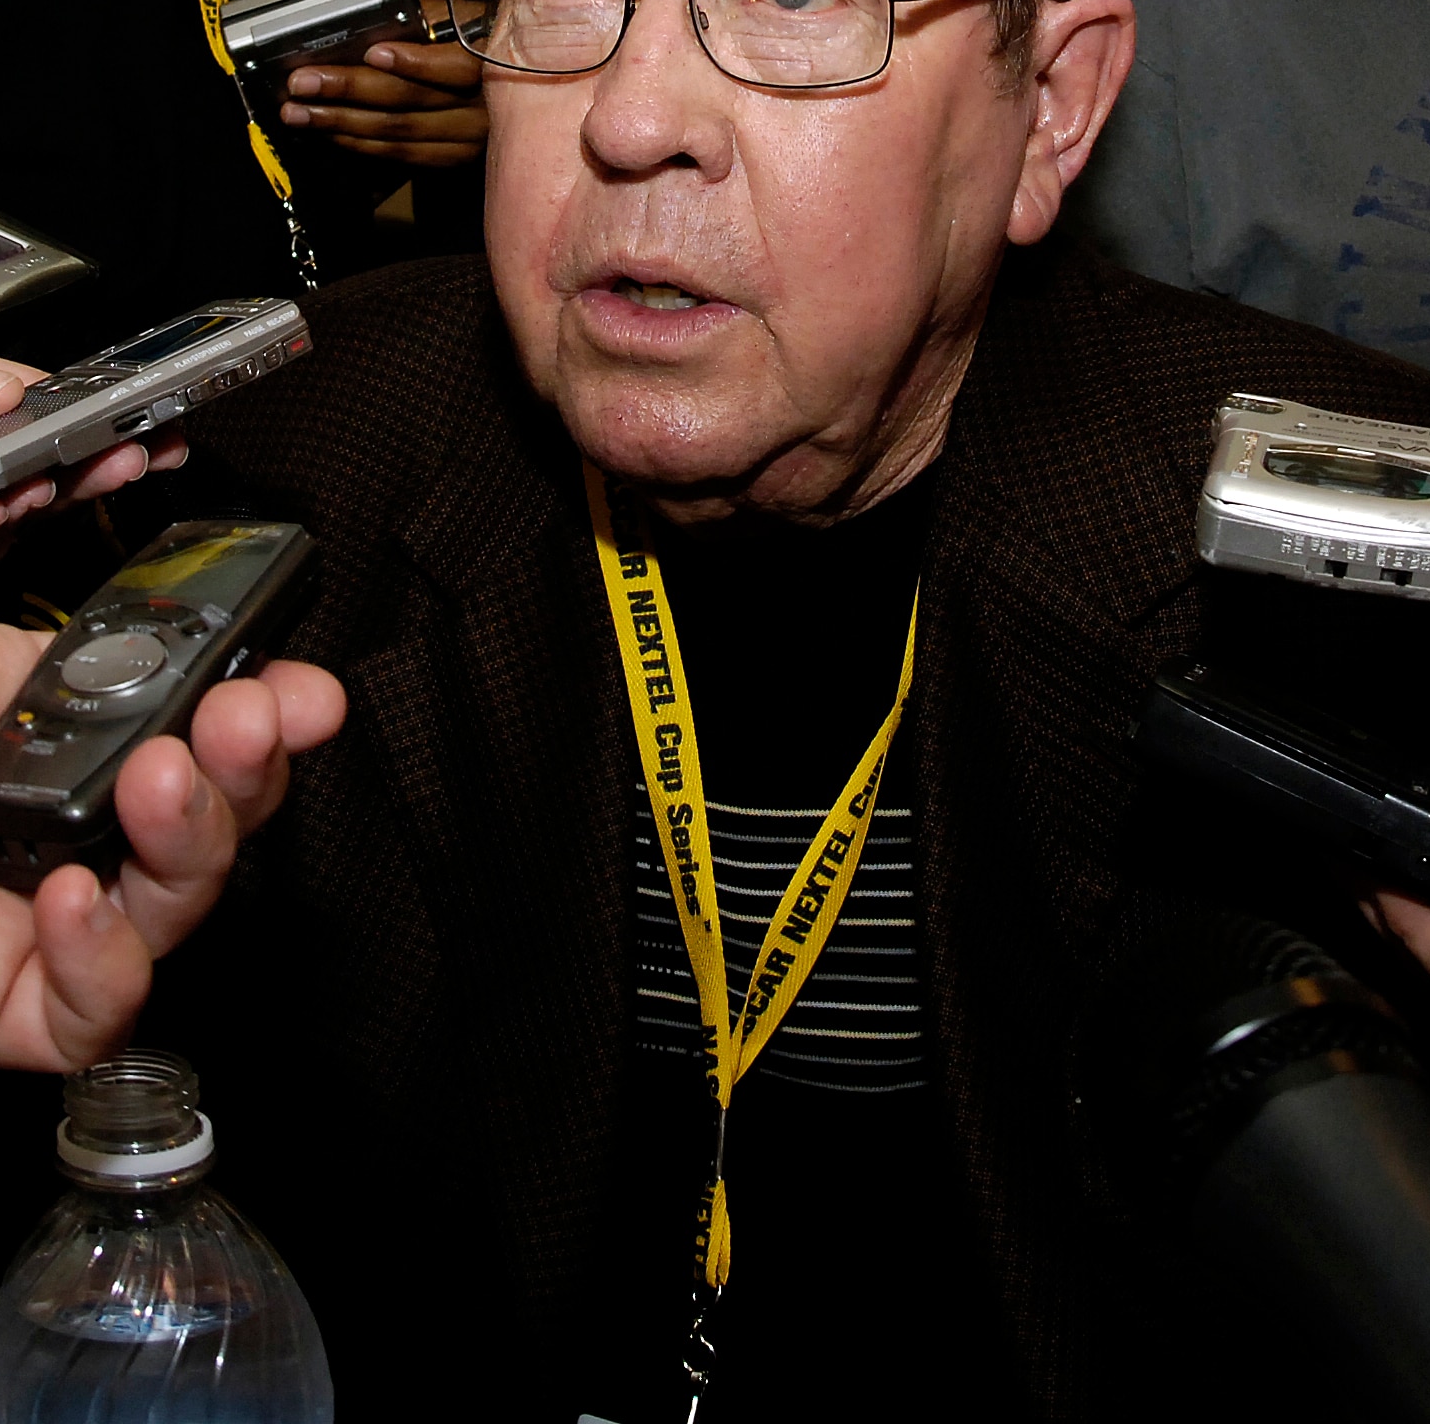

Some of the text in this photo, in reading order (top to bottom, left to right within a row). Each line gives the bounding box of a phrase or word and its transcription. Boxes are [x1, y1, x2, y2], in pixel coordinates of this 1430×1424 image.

[627, 589, 676, 714] NEXTEL
[655, 723, 683, 793] Cup
[667, 802, 701, 916] Series
[779, 828, 858, 945] NEXTEL
